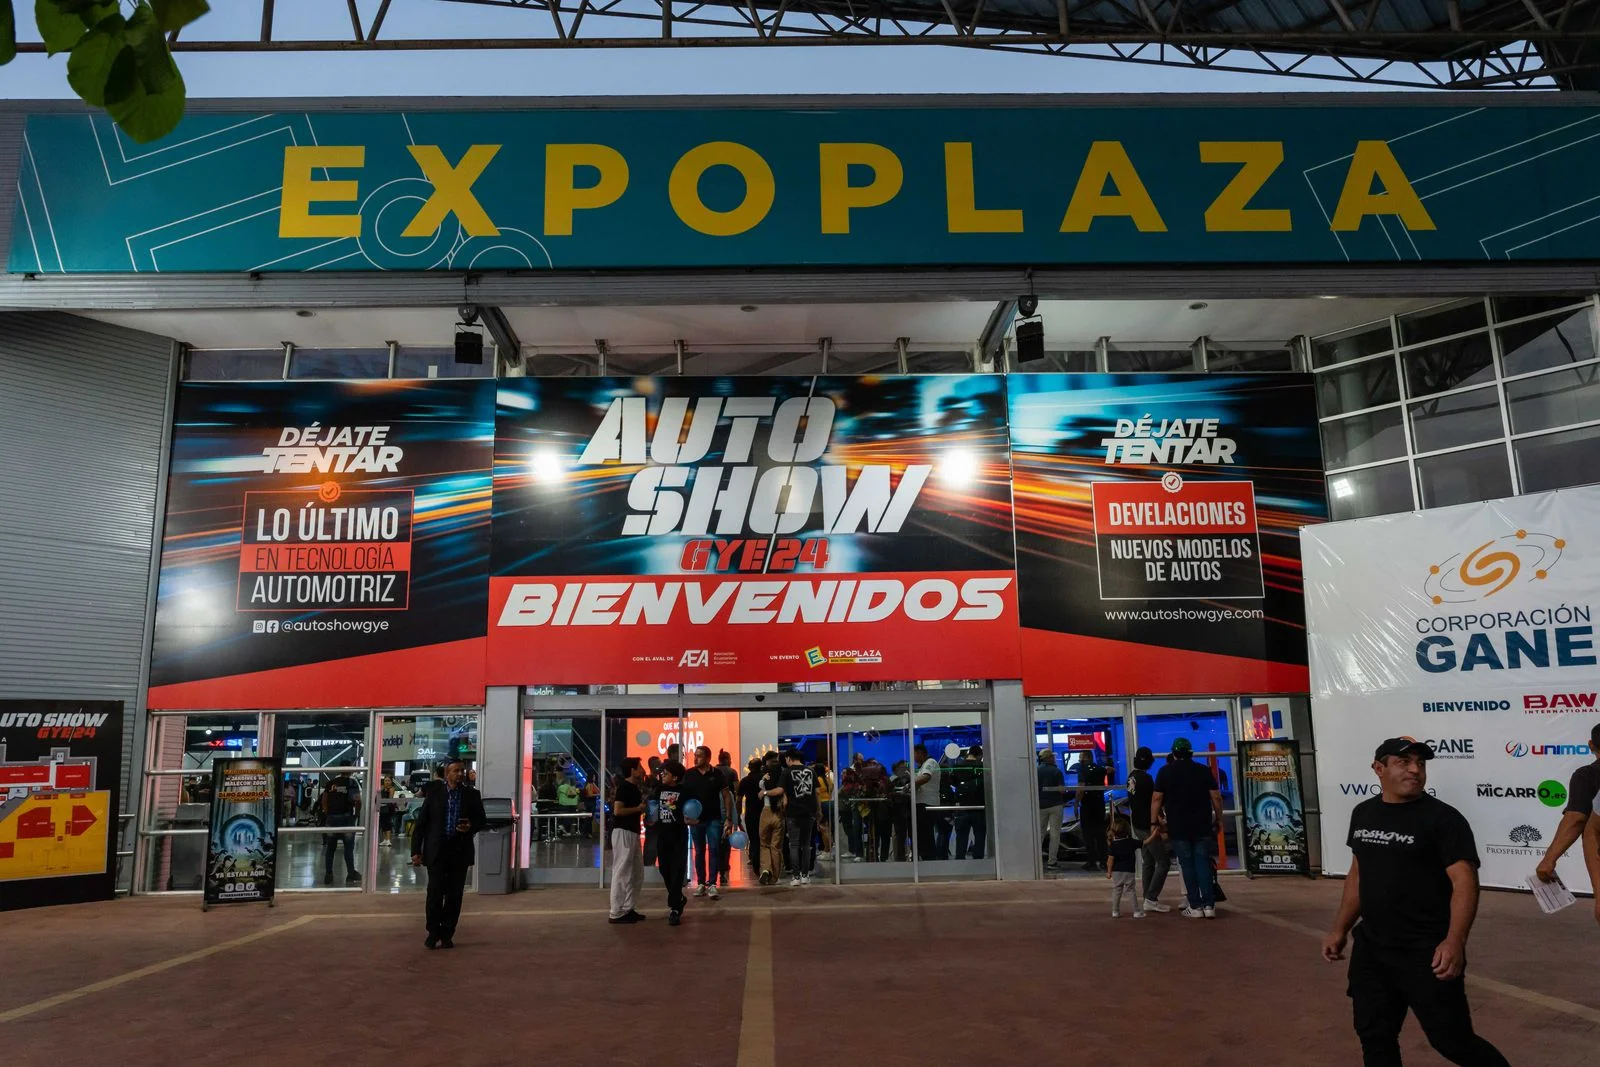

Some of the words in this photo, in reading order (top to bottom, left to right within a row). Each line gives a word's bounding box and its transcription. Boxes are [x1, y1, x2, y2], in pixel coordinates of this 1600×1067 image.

[278, 140, 1438, 239] EXPOPLAZA
[278, 421, 390, 447] DÉJATE
[578, 396, 836, 465] AUTO
[1114, 414, 1220, 438] DÉJATE
[262, 446, 404, 474] TENTAR
[1100, 437, 1237, 465] TENTAR
[621, 465, 932, 536] SHOW
[1109, 501, 1246, 526] DEVELACIONES
[256, 508, 290, 541] LO
[298, 502, 398, 541] ÚLTIMO
[255, 548, 278, 571] EN
[284, 543, 395, 571] TECNOLOGÍA
[1110, 539, 1174, 559] NUEVOS
[1177, 538, 1252, 558] MODELOS
[1145, 562, 1167, 582] DE
[1170, 561, 1222, 581] AUTOS
[250, 574, 396, 603] AUTOMOTRIZ
[496, 577, 1013, 627] BIENVENIDOS
[1104, 607, 1265, 622] www.autoshowgye.com
[281, 619, 389, 634] @autoshowgye
[1416, 604, 1591, 634] CORPORACIÓN
[1415, 626, 1597, 674] GANE
[1422, 700, 1511, 713] BIENVENIDO
[1523, 693, 1598, 709] BAW
[0, 712, 43, 728] UTO
[42, 712, 109, 727] SHOW
[1423, 739, 1474, 753] GANE
[1486, 846, 1532, 855] PROSPERITY
